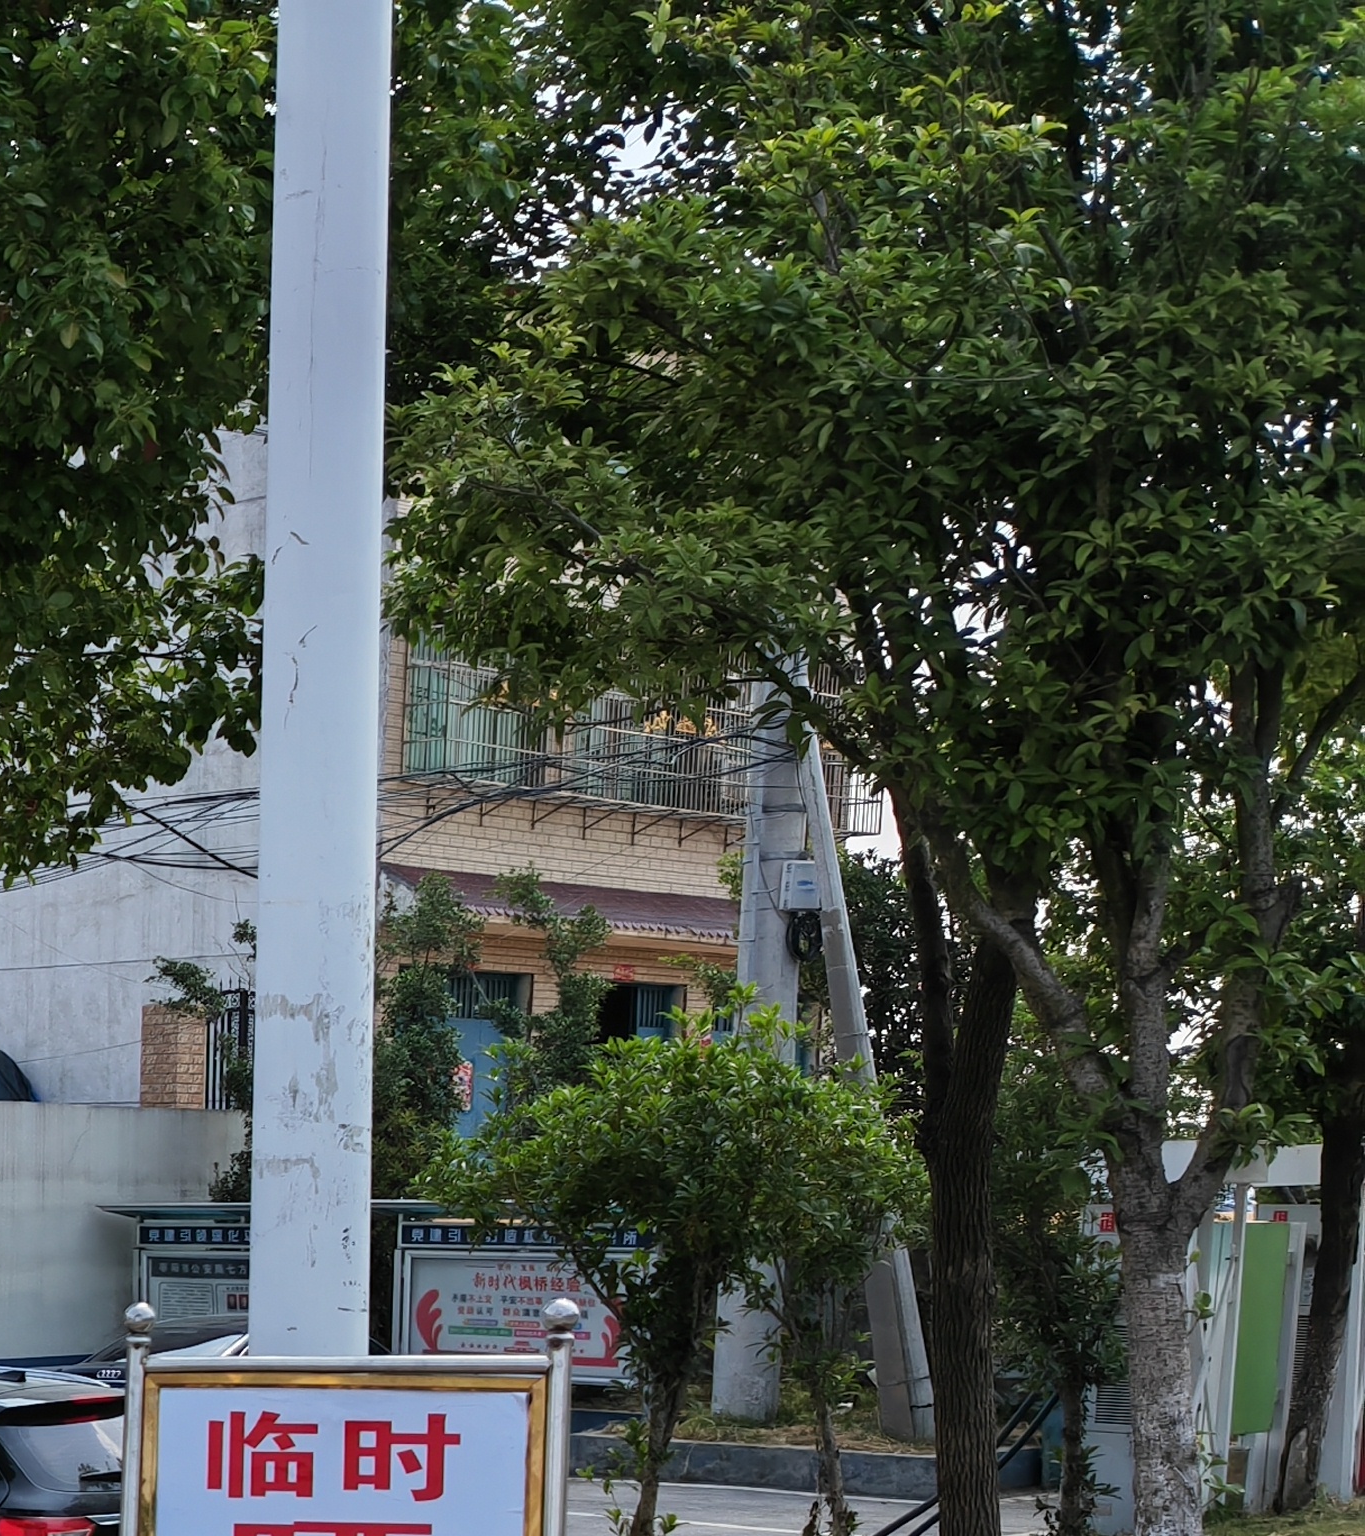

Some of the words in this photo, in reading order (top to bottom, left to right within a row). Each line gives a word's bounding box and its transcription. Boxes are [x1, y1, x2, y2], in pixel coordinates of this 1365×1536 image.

[472, 1272, 582, 1292] 新时代枫桥经验
[206, 1410, 461, 1502] 临时
